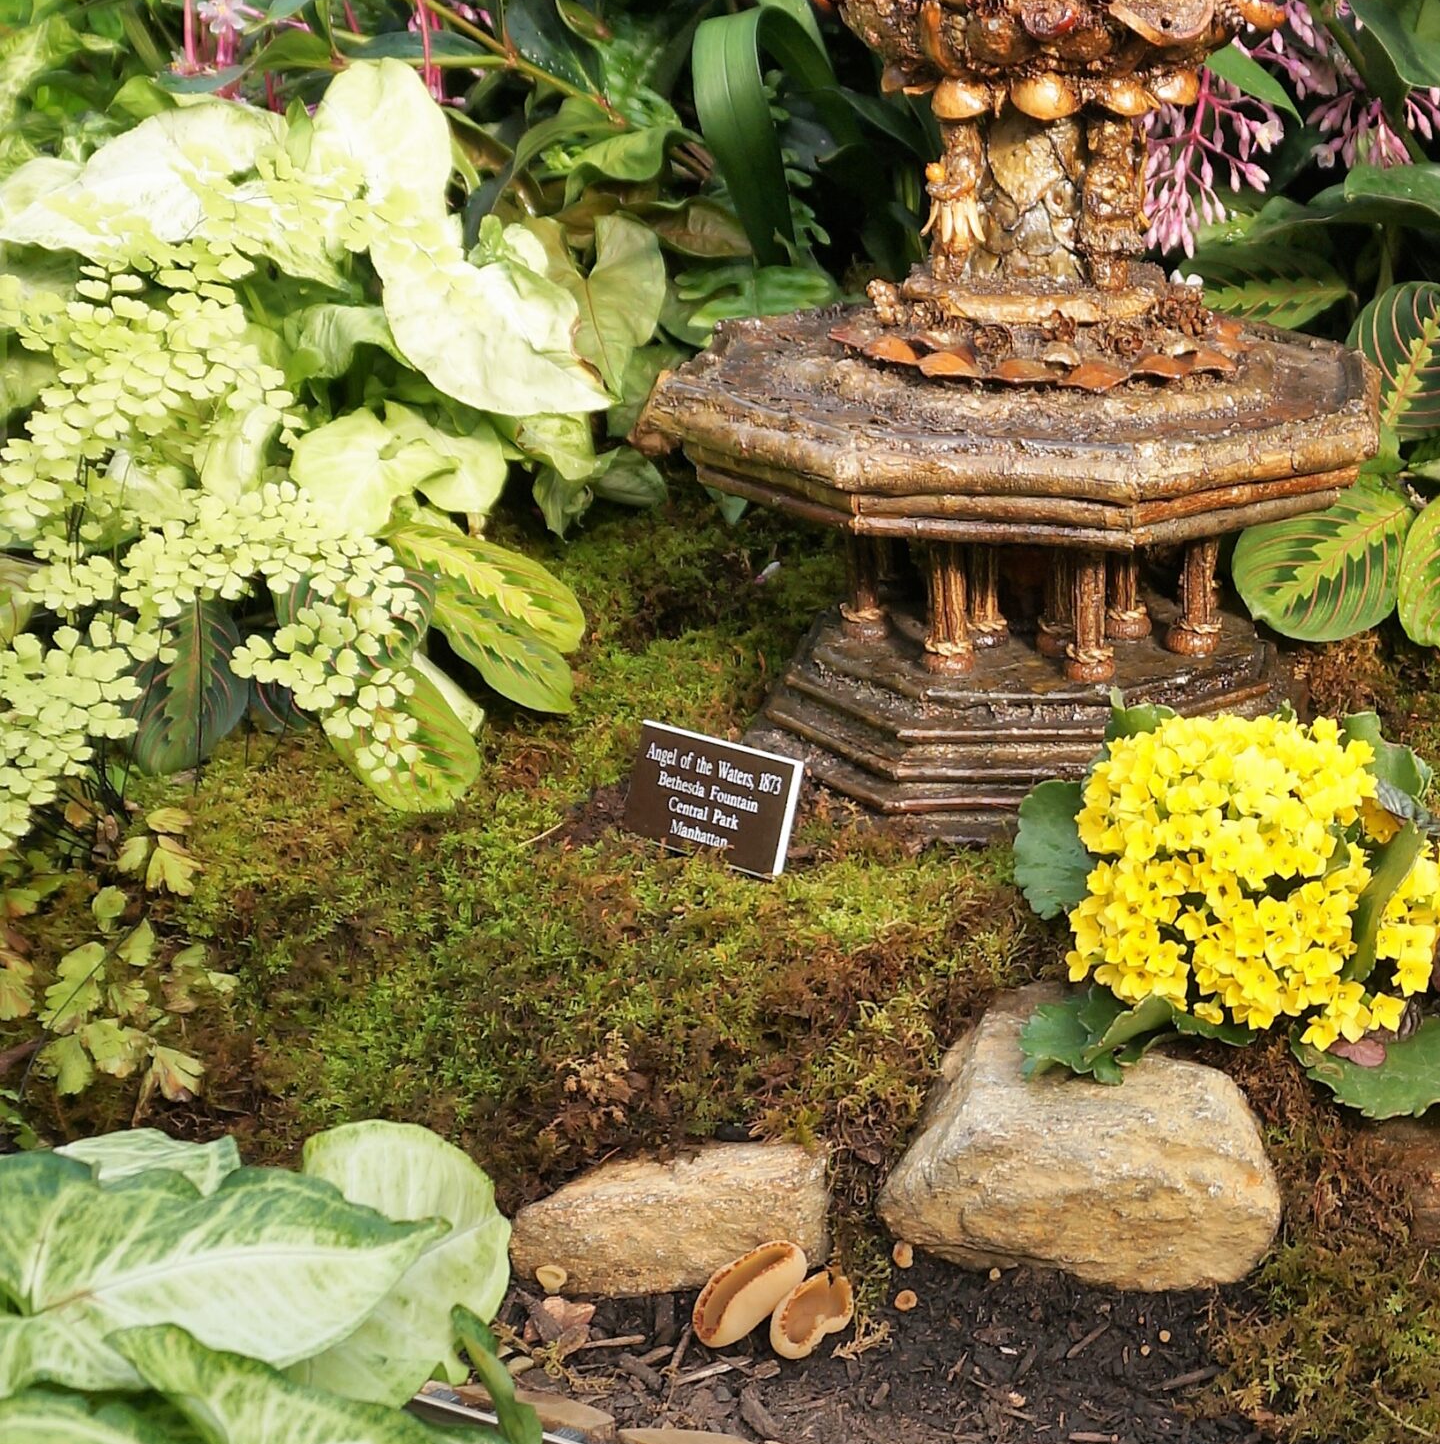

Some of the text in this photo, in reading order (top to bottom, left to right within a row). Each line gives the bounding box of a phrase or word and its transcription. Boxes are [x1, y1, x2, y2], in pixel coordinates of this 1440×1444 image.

[646, 742, 782, 795] Angel of the Waters, 1873
[658, 771, 759, 813] Bethesda Fountain
[668, 796, 740, 830] Central Park
[669, 819, 729, 847] Manhattan
